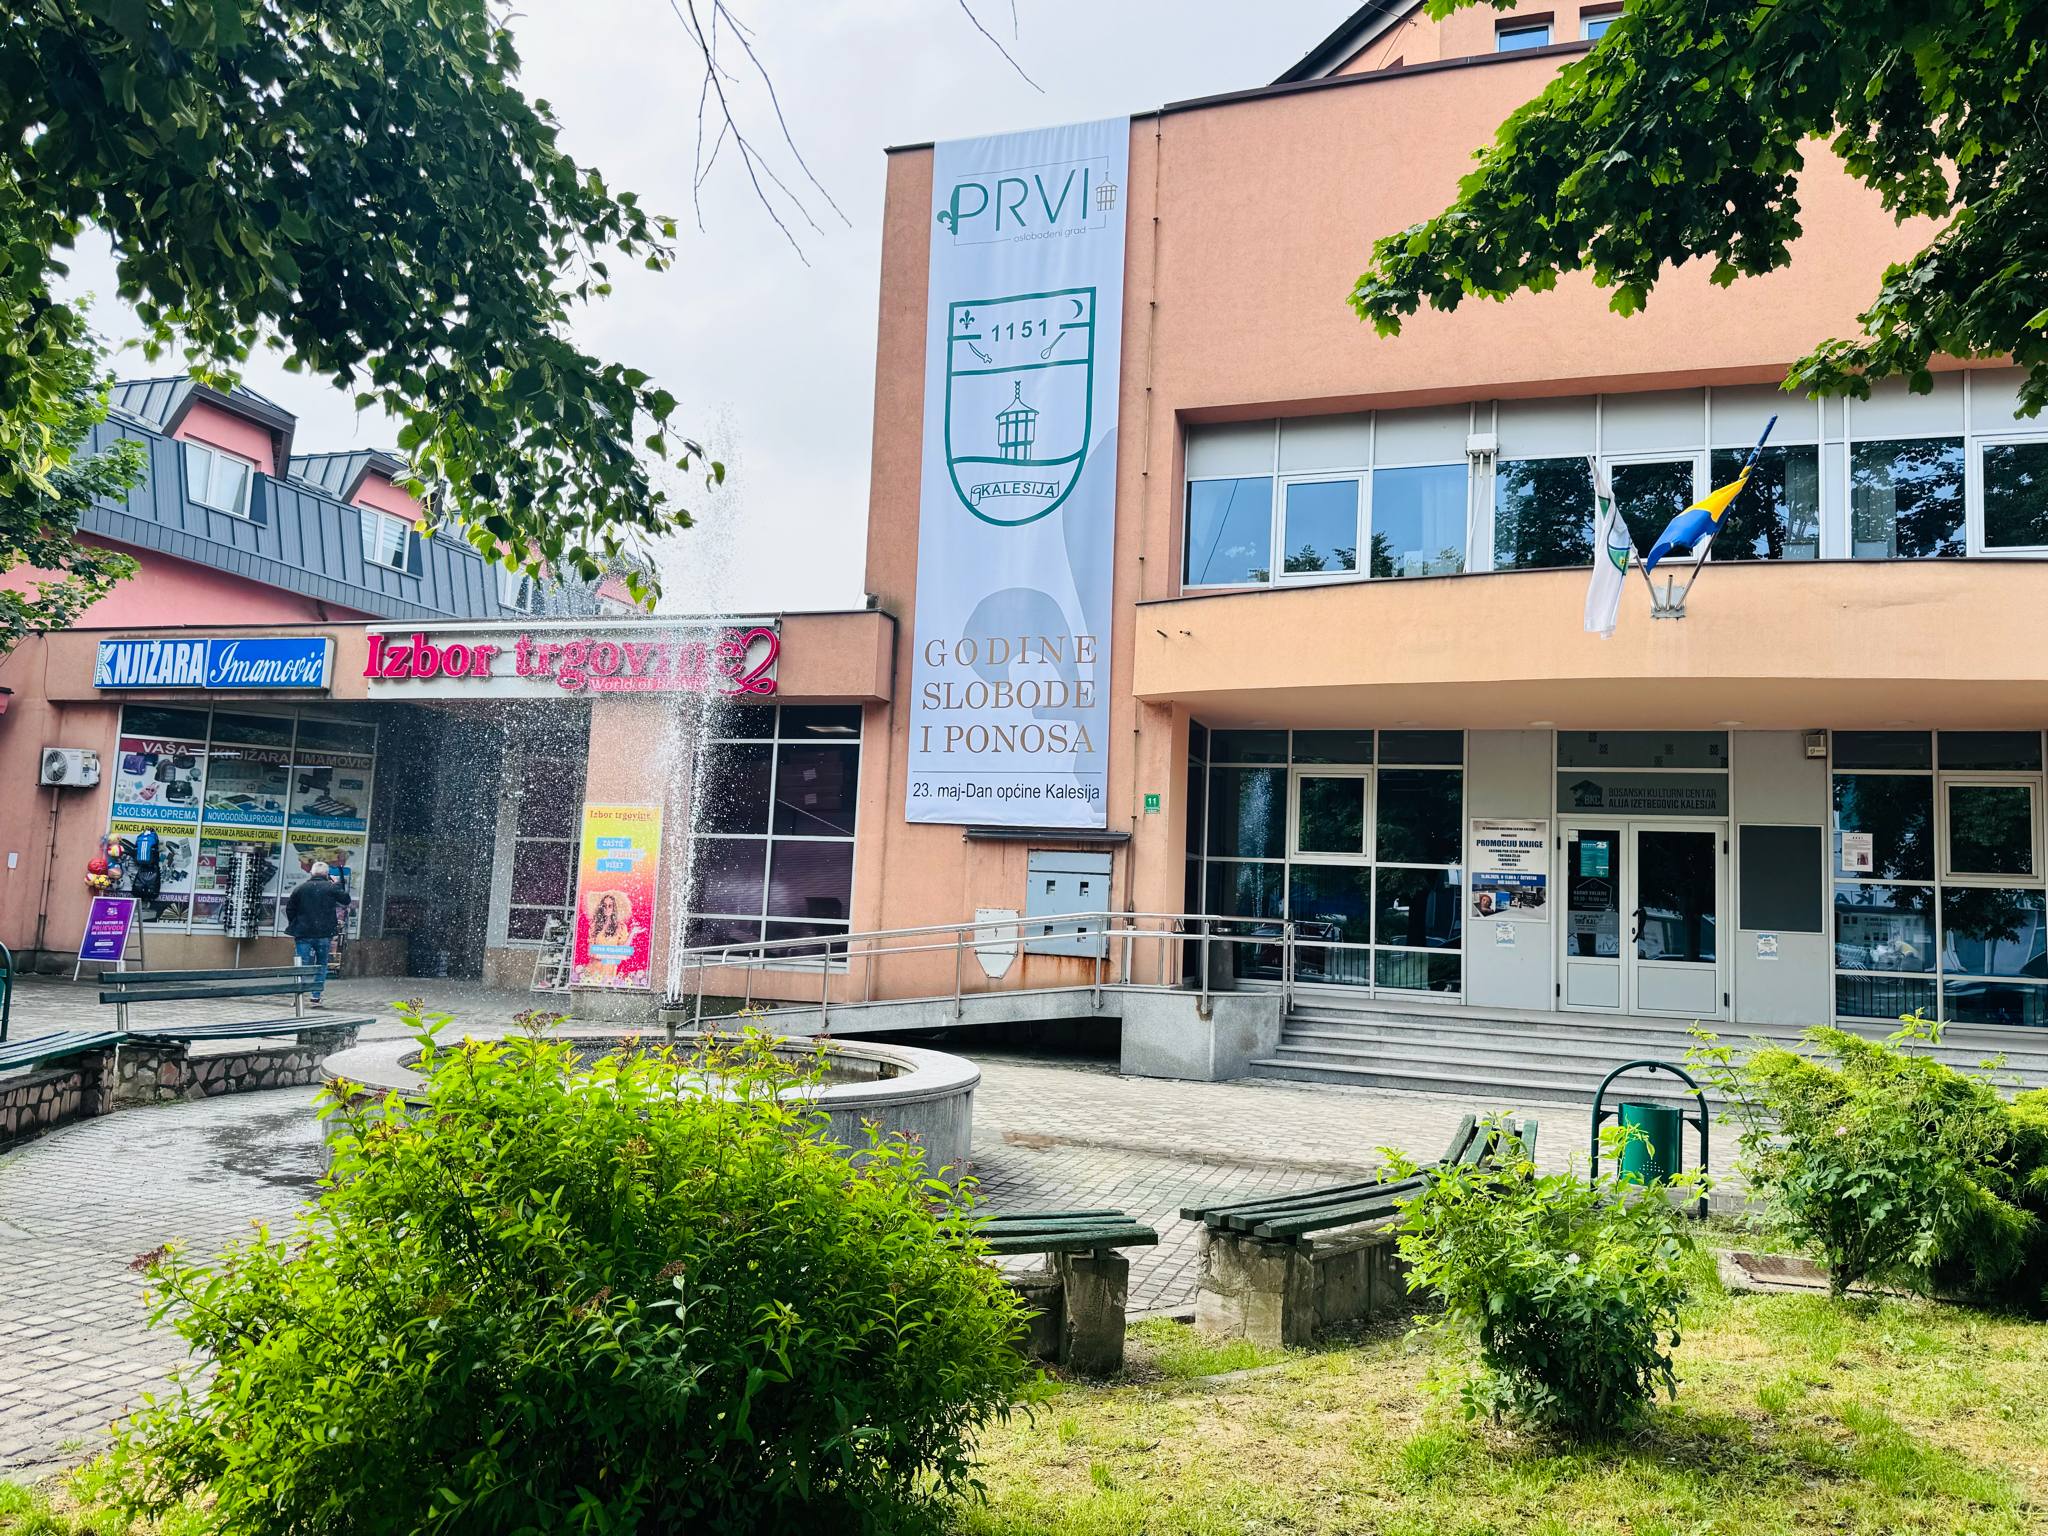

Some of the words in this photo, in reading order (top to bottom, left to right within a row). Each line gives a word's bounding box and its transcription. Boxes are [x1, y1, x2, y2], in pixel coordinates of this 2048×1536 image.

[949, 167, 1089, 235] PRVI
[1064, 225, 1086, 238] grad
[991, 318, 1048, 342] 1151
[981, 482, 1055, 497] KALESIJA
[362, 632, 498, 678] Izbor
[924, 635, 1098, 667] GODINE
[97, 640, 204, 685] KNJIŽARA
[209, 641, 324, 684] Imamović
[589, 677, 632, 691] World
[922, 680, 1096, 710] SLOBODE
[919, 725, 933, 753] I
[943, 724, 1095, 754] PONOSA
[142, 741, 188, 755] VAŠA
[913, 782, 933, 798] 23.
[937, 782, 992, 803] maj-Dan
[997, 782, 1041, 802] općine
[1046, 783, 1100, 804] Kalesija
[116, 805, 159, 818] ŠKOLSKA
[161, 809, 197, 820] OPREMA
[590, 810, 613, 819] Izbor
[162, 827, 195, 836] PROGRAM
[204, 828, 229, 837] PROGRAM
[291, 833, 324, 844] DJEČIJE
[325, 836, 361, 845] IGRAČKE
[1476, 839, 1518, 848] PROMOCIJU
[1518, 840, 1543, 849] KNJIGE
